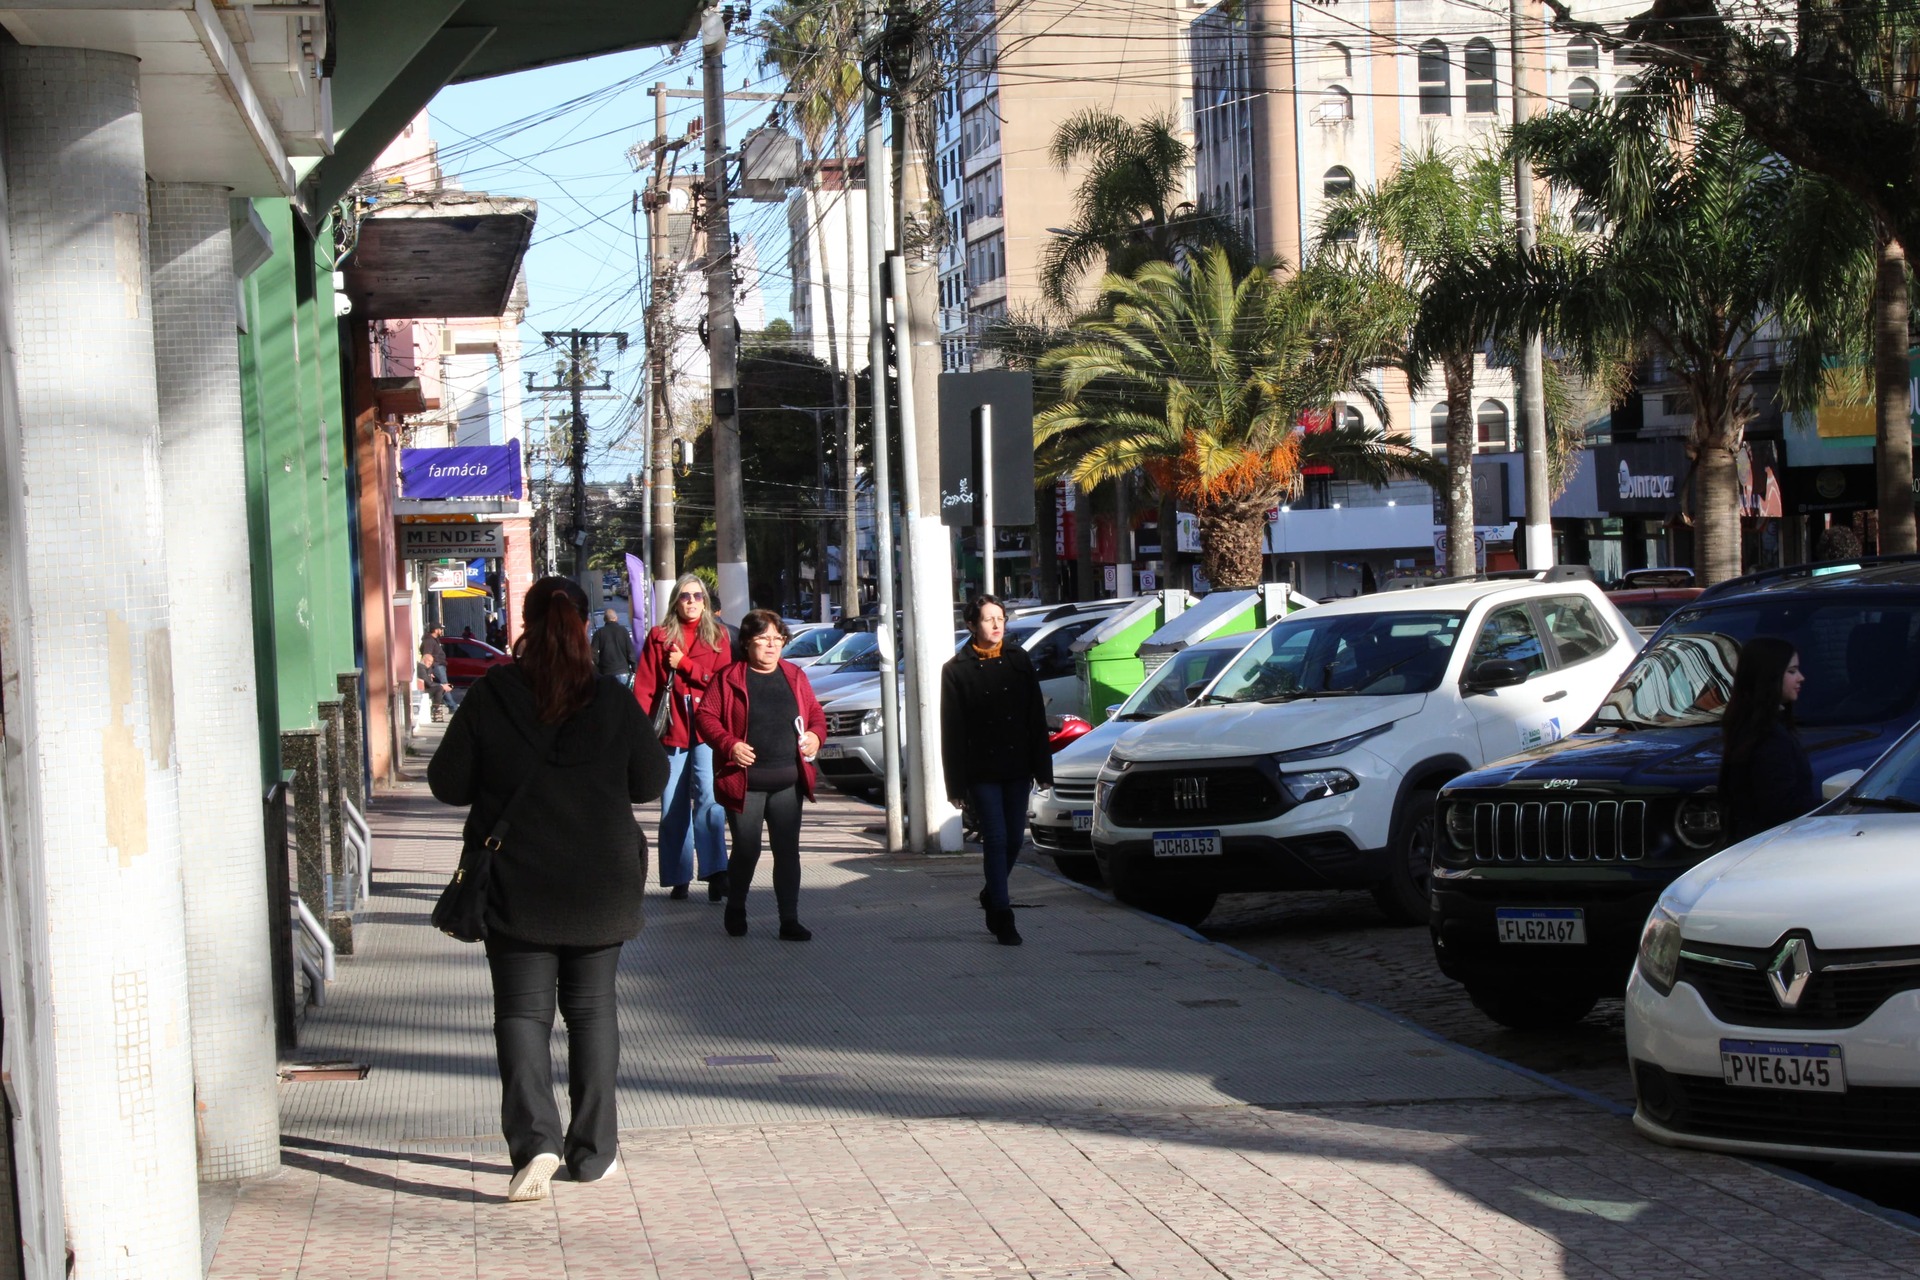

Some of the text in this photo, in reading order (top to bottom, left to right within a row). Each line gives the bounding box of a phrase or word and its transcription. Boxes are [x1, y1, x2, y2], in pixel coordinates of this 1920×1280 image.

[429, 463, 488, 477] farmácia
[407, 529, 496, 543] MENDES
[1543, 778, 1578, 789] Jeep
[1174, 777, 1208, 810] FIAT
[1159, 838, 1214, 855] JCH8I53
[1505, 920, 1575, 942] FLG2A67
[1731, 1055, 1830, 1087] PYE6J45
